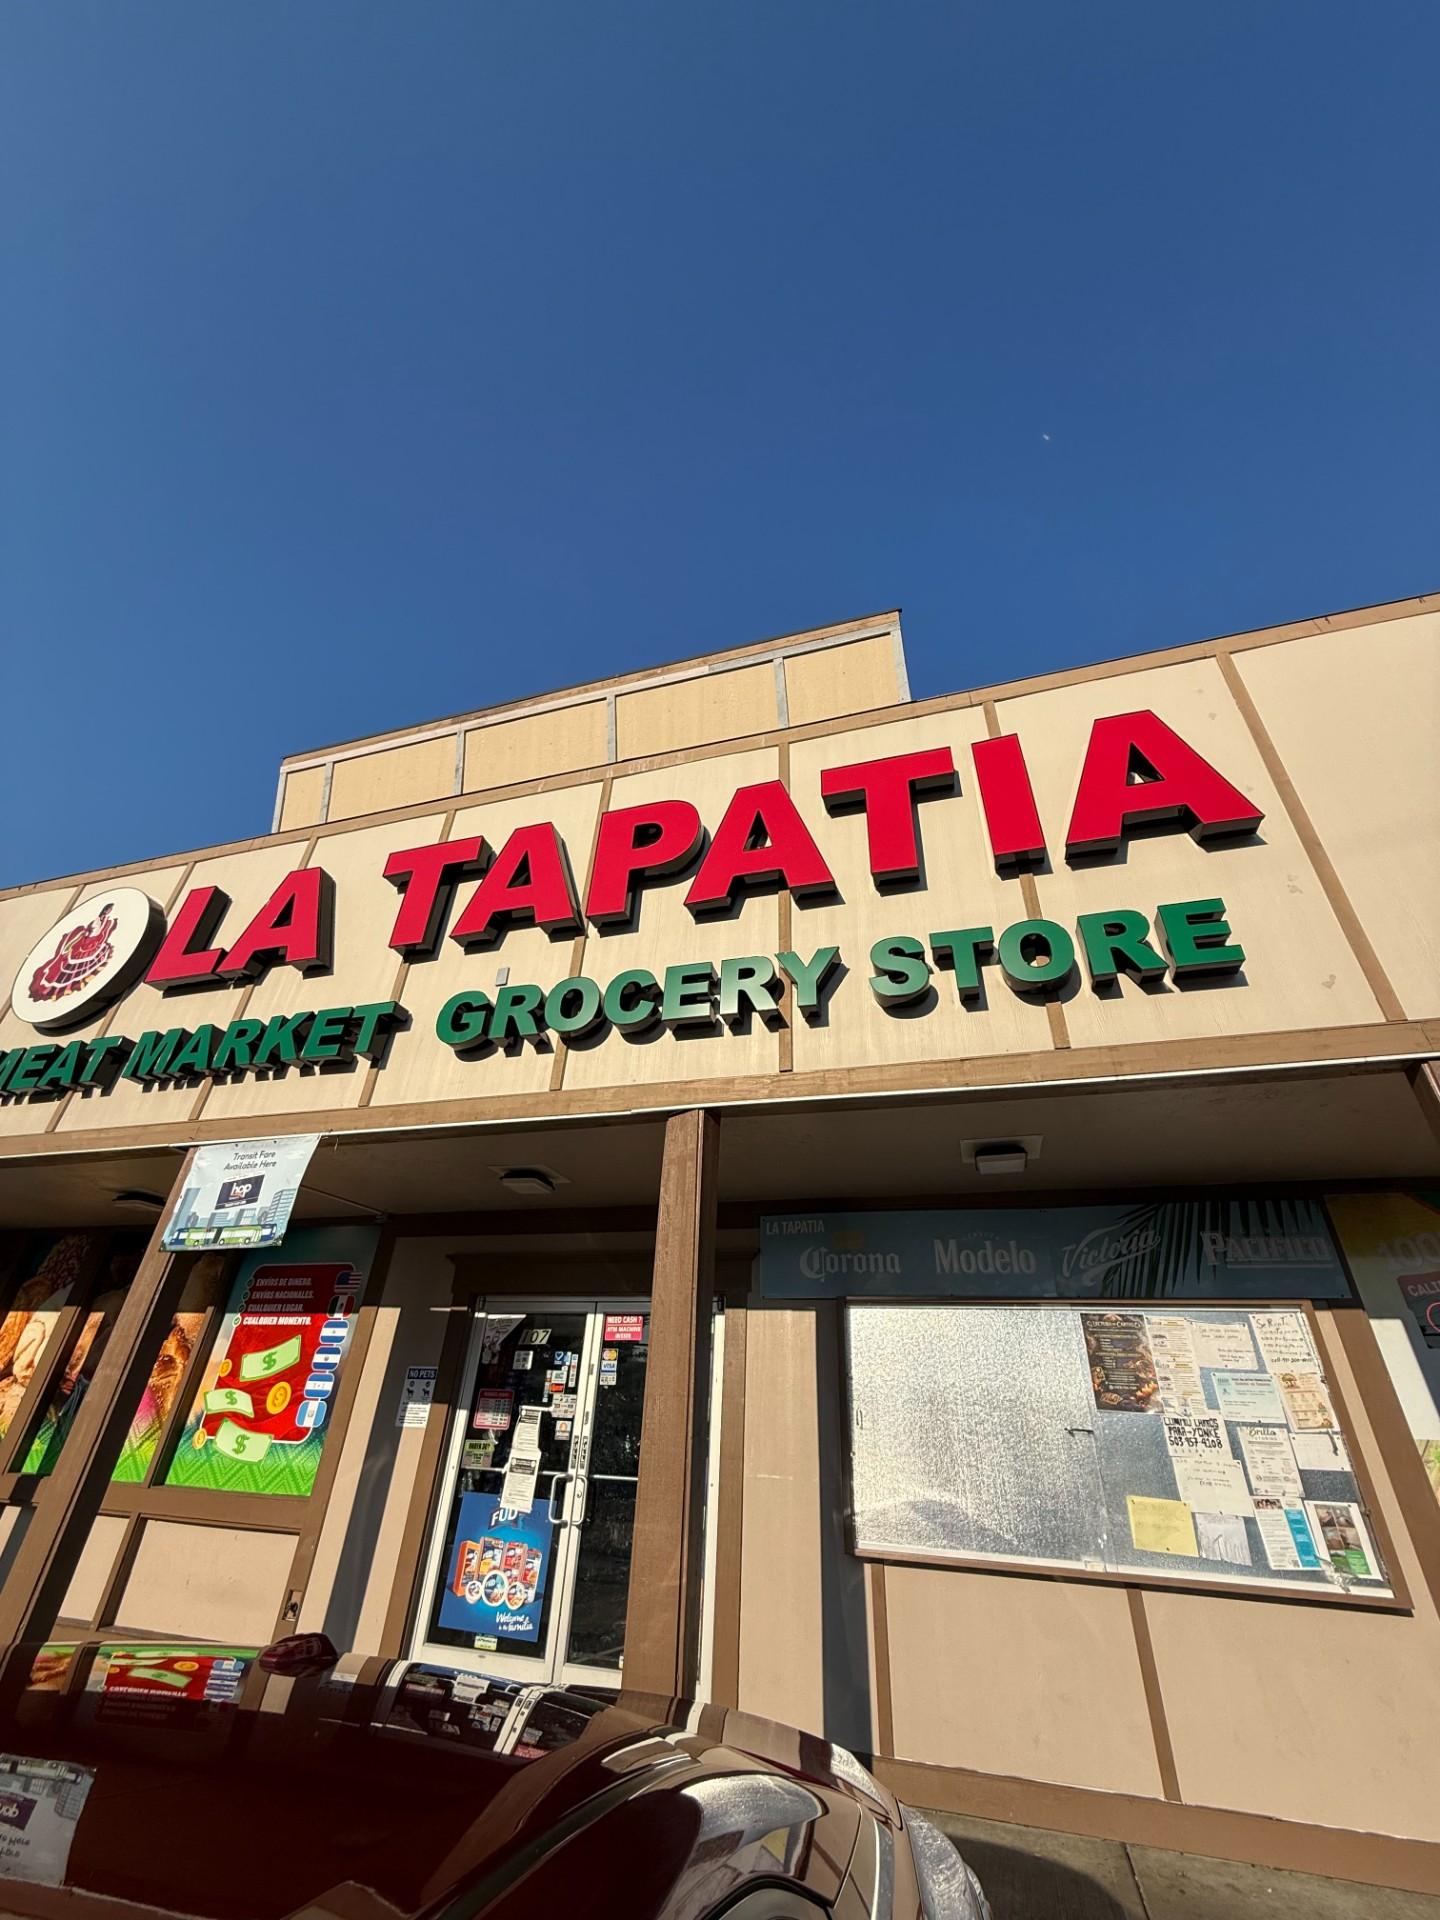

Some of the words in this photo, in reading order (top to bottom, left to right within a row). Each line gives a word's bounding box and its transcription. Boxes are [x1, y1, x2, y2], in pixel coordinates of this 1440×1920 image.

[146, 867, 324, 984] LA
[383, 711, 1261, 950] TAPATIA
[122, 1001, 402, 1079] MARKET
[437, 948, 838, 1050] GROCERY
[872, 899, 1244, 1004] STORE
[233, 1151, 258, 1161] Transit
[259, 1150, 276, 1159] Fare
[224, 1161, 258, 1171] Available
[259, 1160, 277, 1168] Here
[231, 1182, 253, 1198] hop
[766, 1222, 779, 1236] LA
[782, 1219, 825, 1235] TAPATIA
[800, 1247, 901, 1283] Corona
[933, 1238, 1037, 1276] Modelo
[1061, 1219, 1162, 1280] Victoria
[409, 1370, 419, 1378] NO
[419, 1370, 436, 1378] PETS
[491, 1508, 518, 1527] FUD
